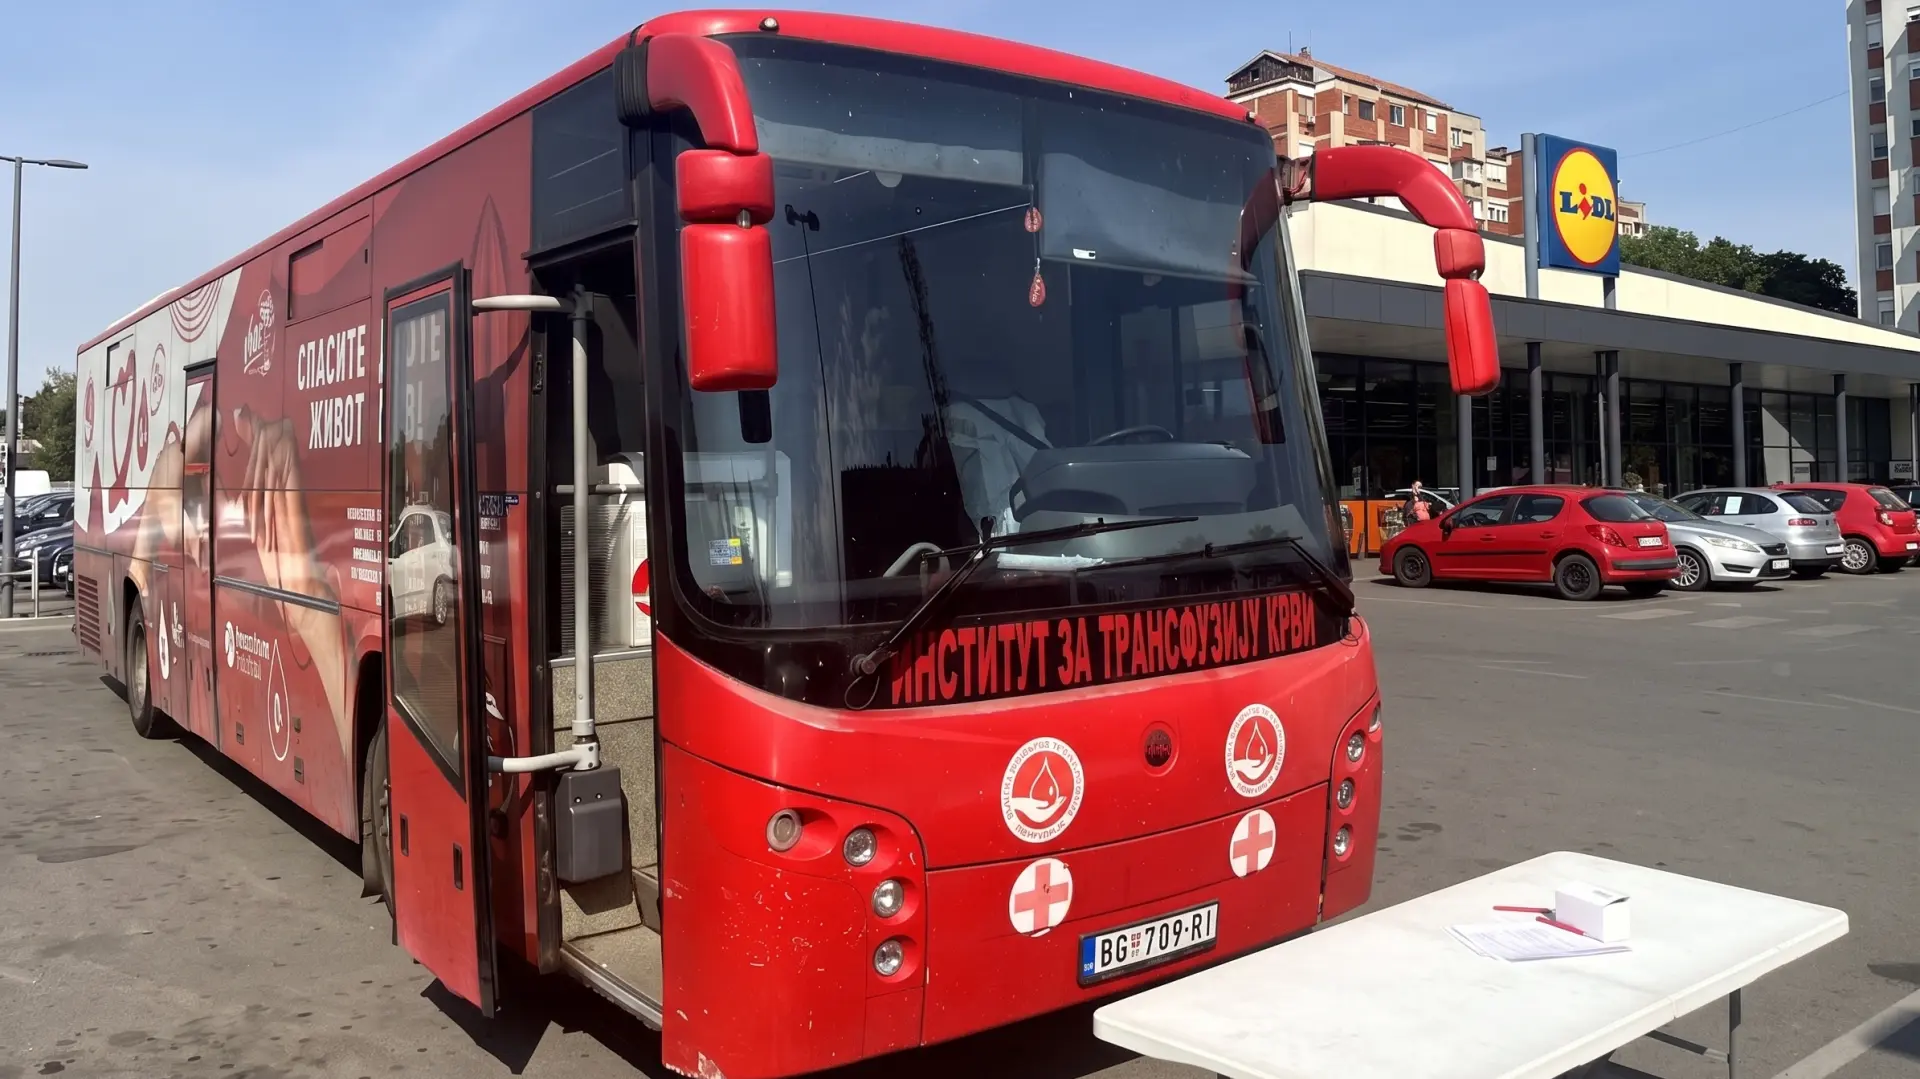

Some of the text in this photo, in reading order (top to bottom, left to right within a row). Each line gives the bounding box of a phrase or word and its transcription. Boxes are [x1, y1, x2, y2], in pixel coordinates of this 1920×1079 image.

[1559, 183, 1614, 222] LIDL
[297, 324, 366, 390] СПАСИТЕ
[309, 392, 365, 449] ЖИВОТ
[891, 592, 1316, 705] ИНСТИТУТ ЗА ТРАНСФУЗИЈУ КРВИ
[1100, 934, 1128, 968] BG
